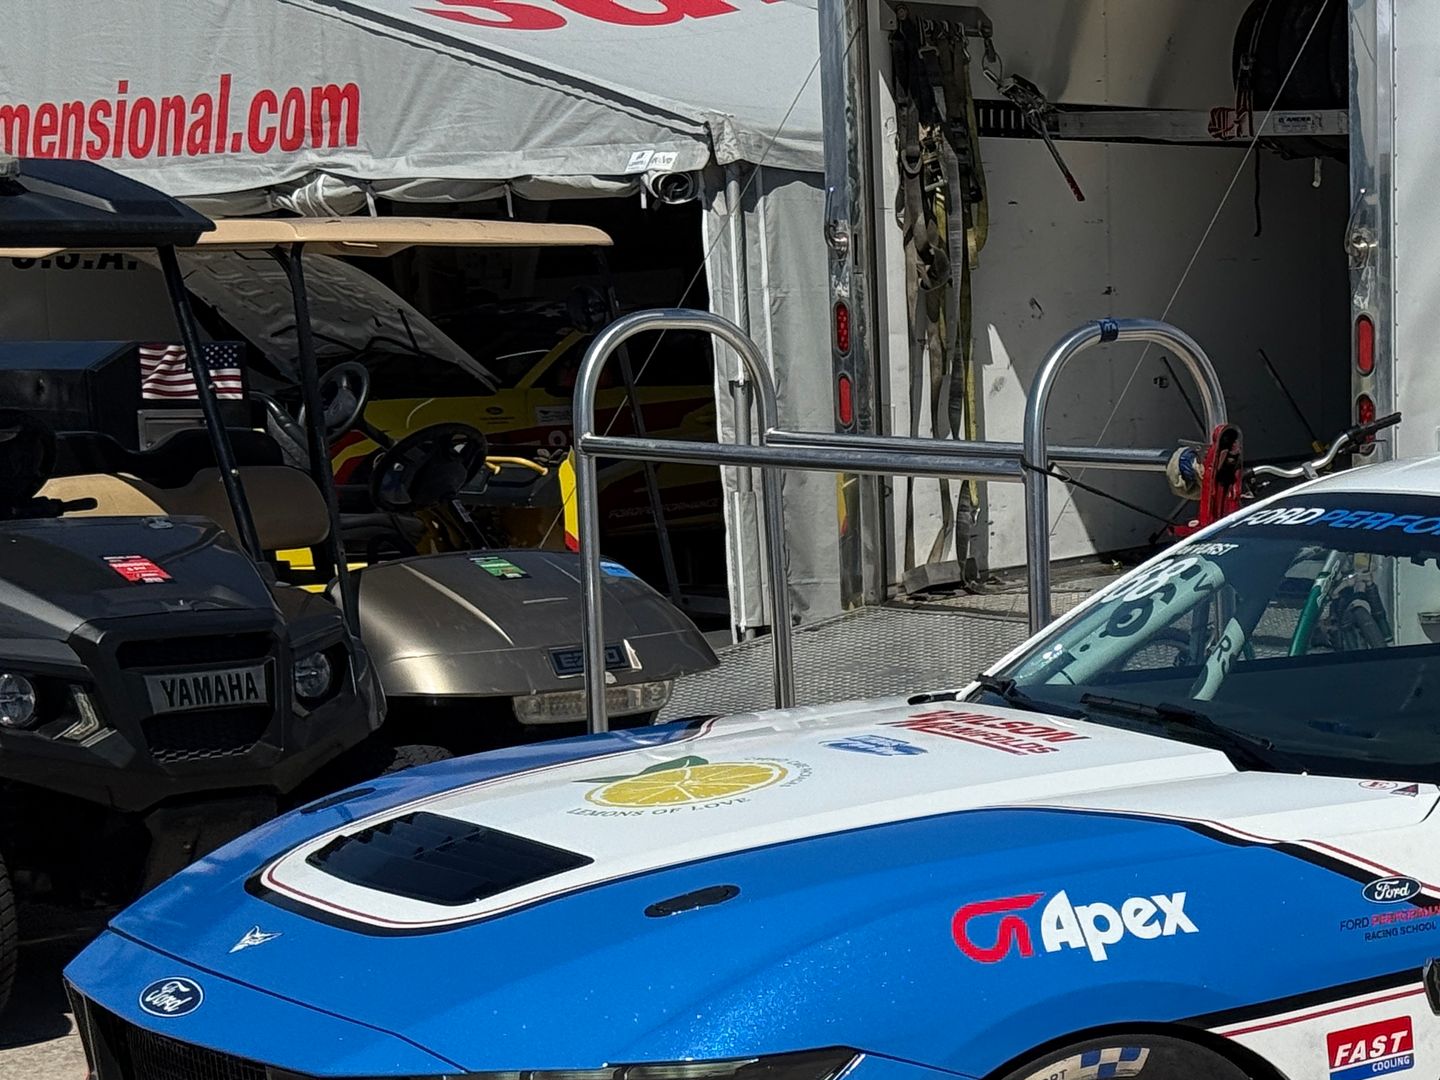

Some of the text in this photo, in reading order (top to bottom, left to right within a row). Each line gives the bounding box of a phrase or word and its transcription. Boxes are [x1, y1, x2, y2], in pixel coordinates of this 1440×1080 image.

[160, 672, 260, 707] YAMAHA
[566, 797, 750, 817] LEMONS OF LOVE
[1374, 880, 1411, 901] Ford
[1040, 889, 1200, 962] Apex
[1340, 917, 1370, 932] FORD
[1364, 921, 1438, 942] RACING SCHOOL
[145, 980, 192, 1012] Ford
[1333, 1029, 1409, 1067] FAST
[1371, 1054, 1410, 1072] COOLING
